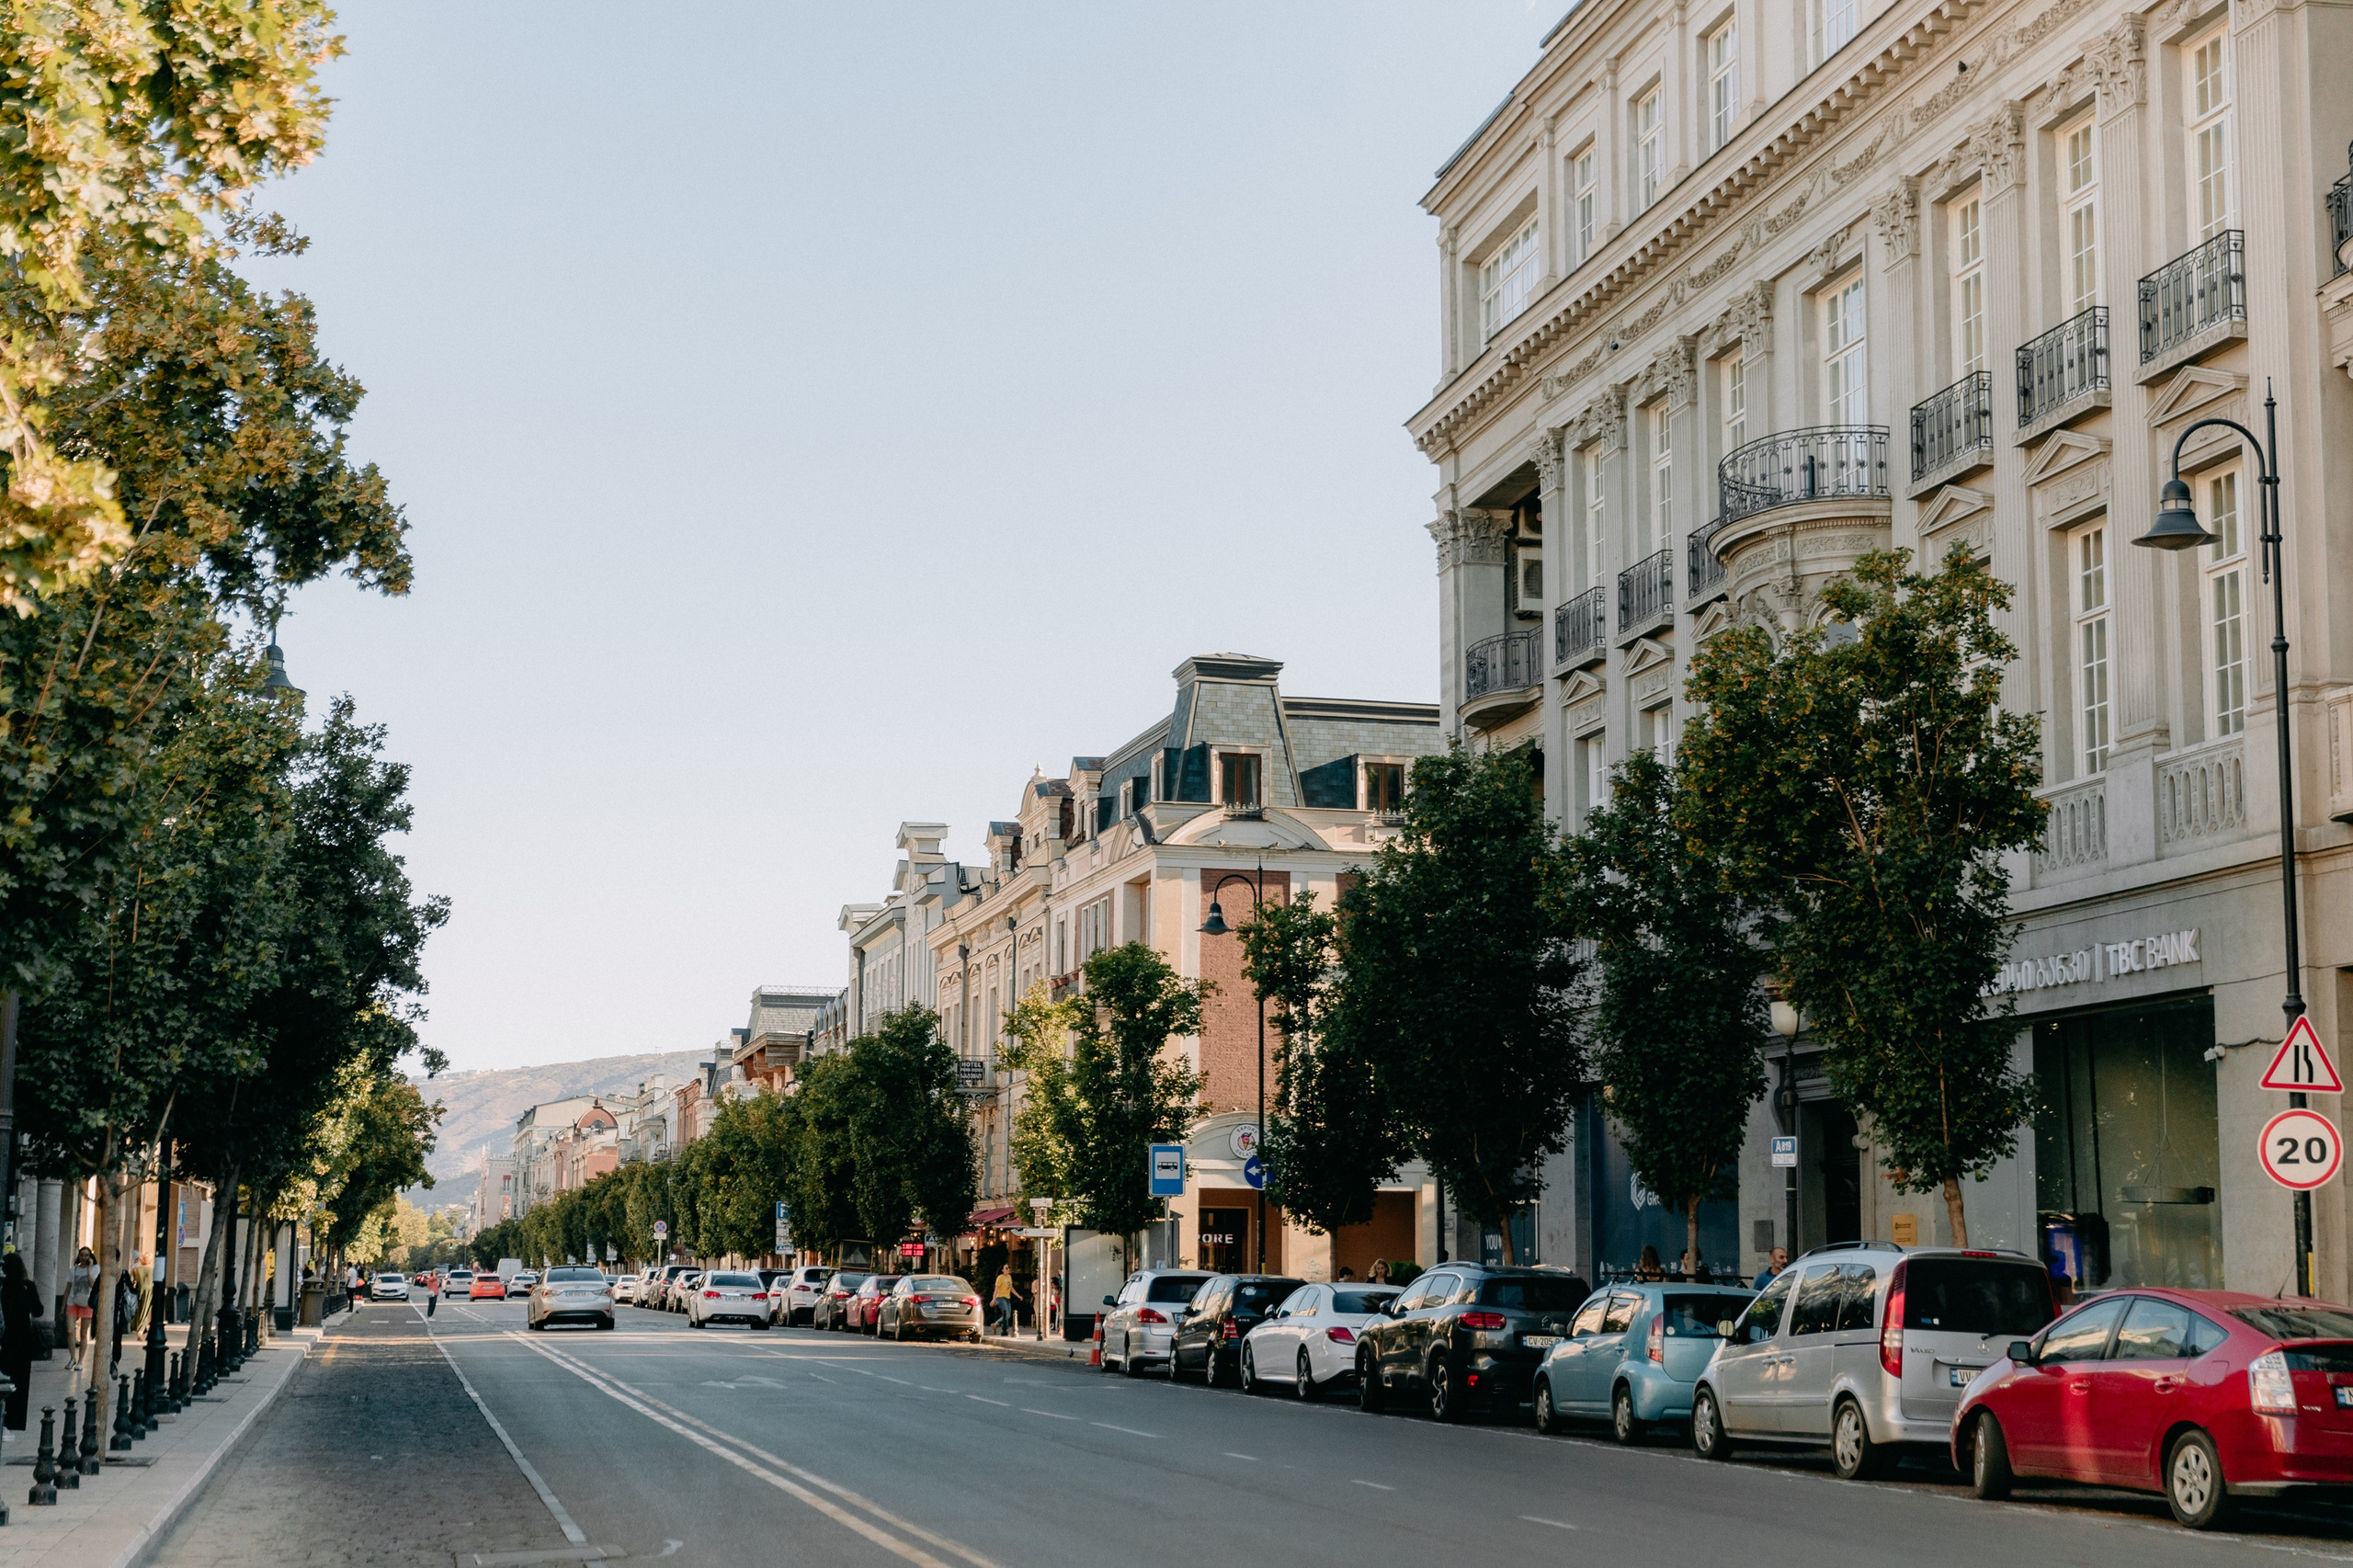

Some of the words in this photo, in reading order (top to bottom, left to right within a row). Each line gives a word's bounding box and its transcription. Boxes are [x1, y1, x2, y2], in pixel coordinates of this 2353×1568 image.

[2036, 949, 2091, 989] ბანკი
[2106, 939, 2146, 976] TBC
[2145, 927, 2201, 970] BANK
[2277, 1137, 2326, 1165] 20
